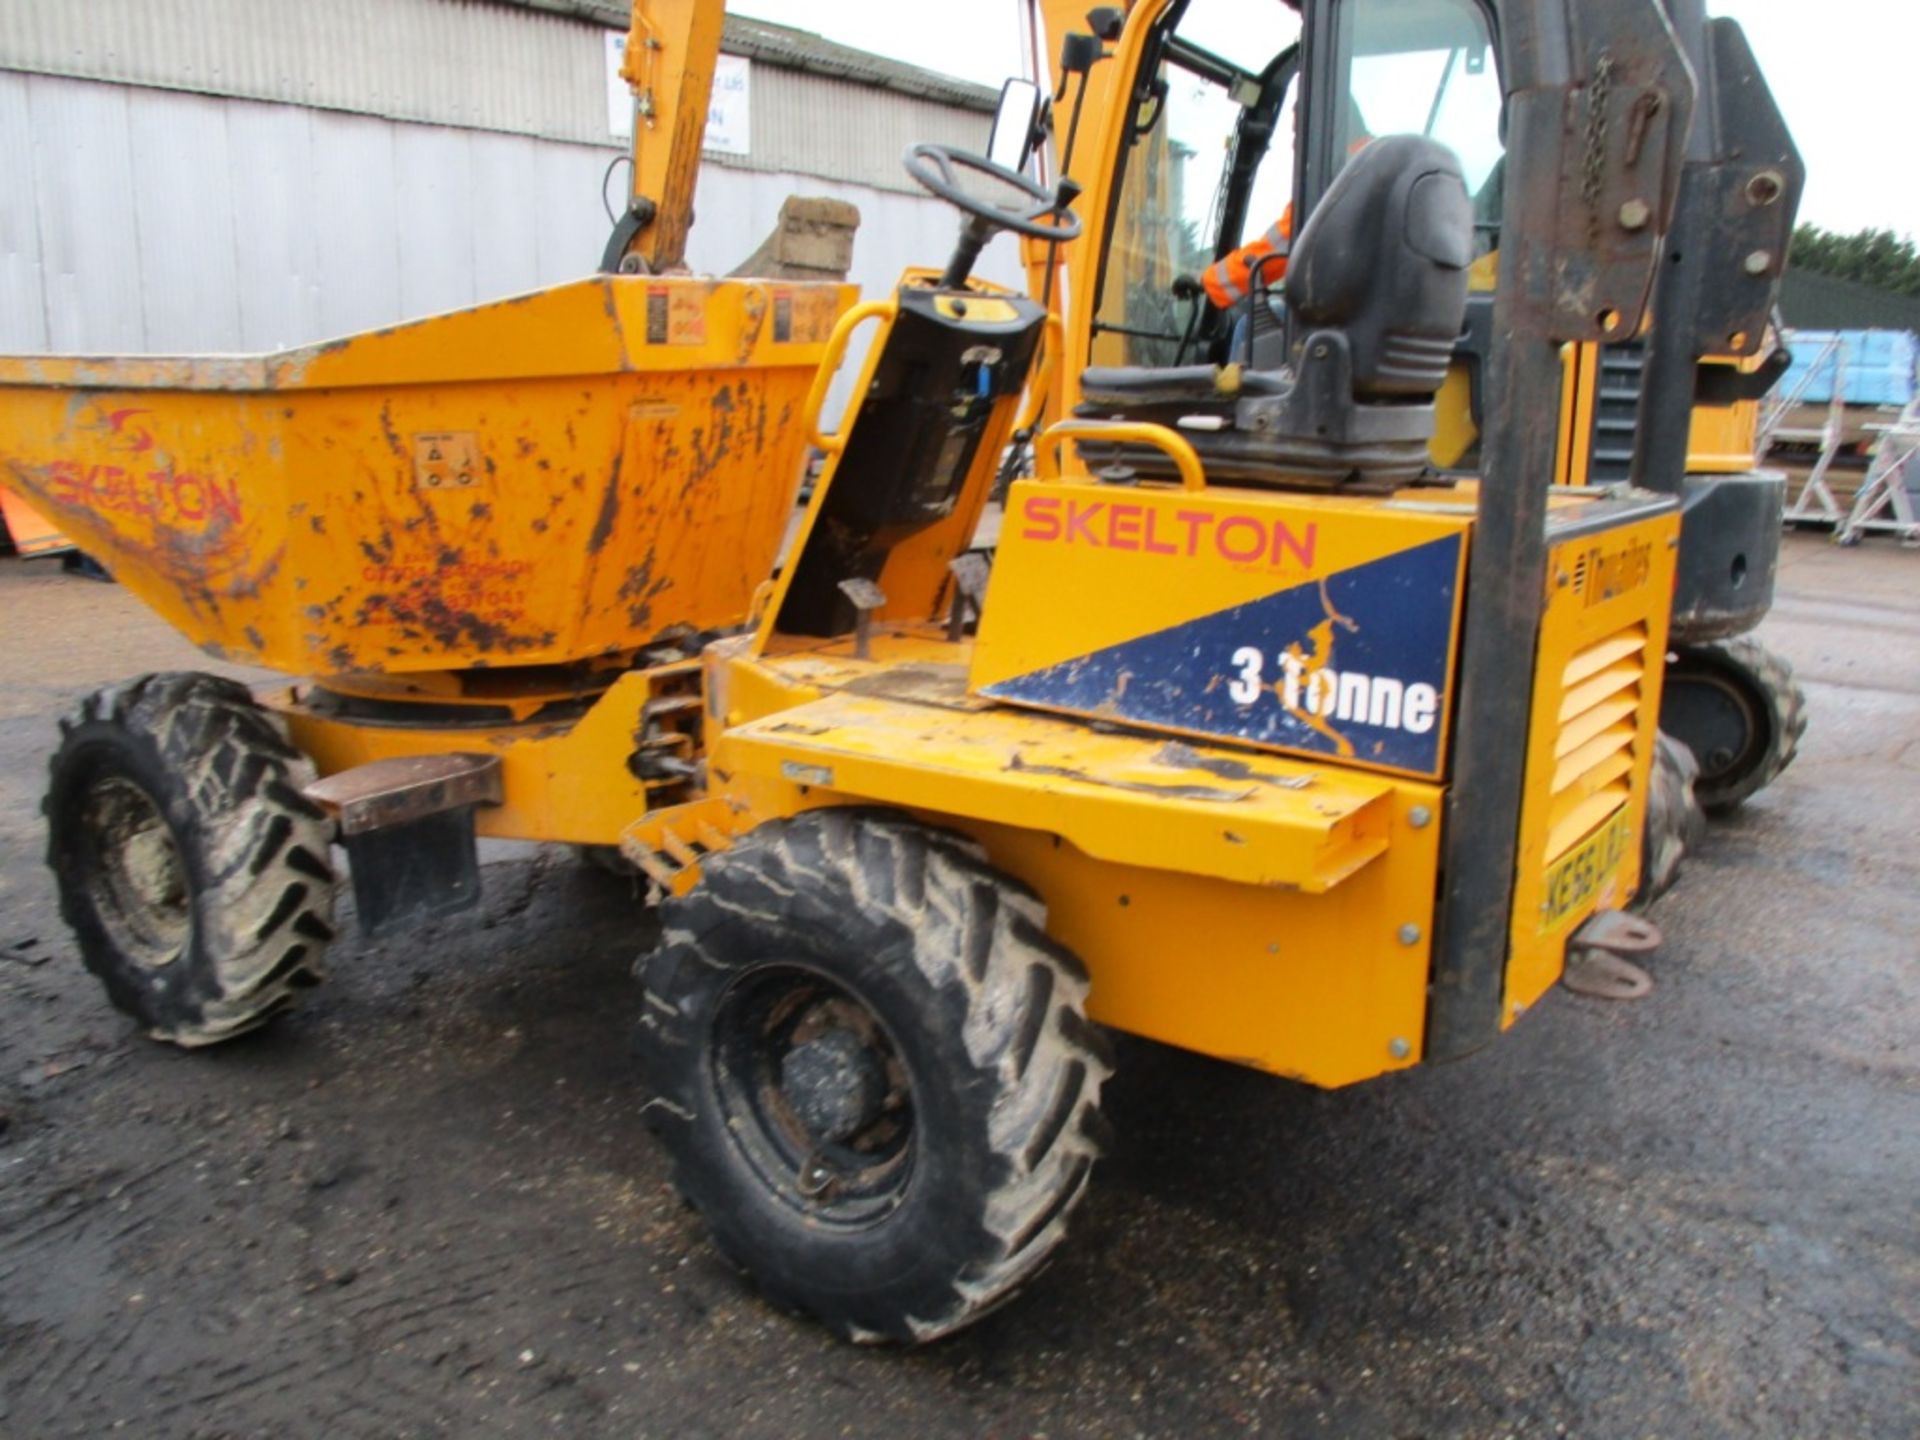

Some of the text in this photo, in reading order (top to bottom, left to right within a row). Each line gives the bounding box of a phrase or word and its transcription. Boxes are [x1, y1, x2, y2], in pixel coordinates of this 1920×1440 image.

[47, 460, 244, 525] SKELTON
[1022, 496, 1318, 570] SKELTON
[1228, 646, 1438, 734] 3 Tonne
